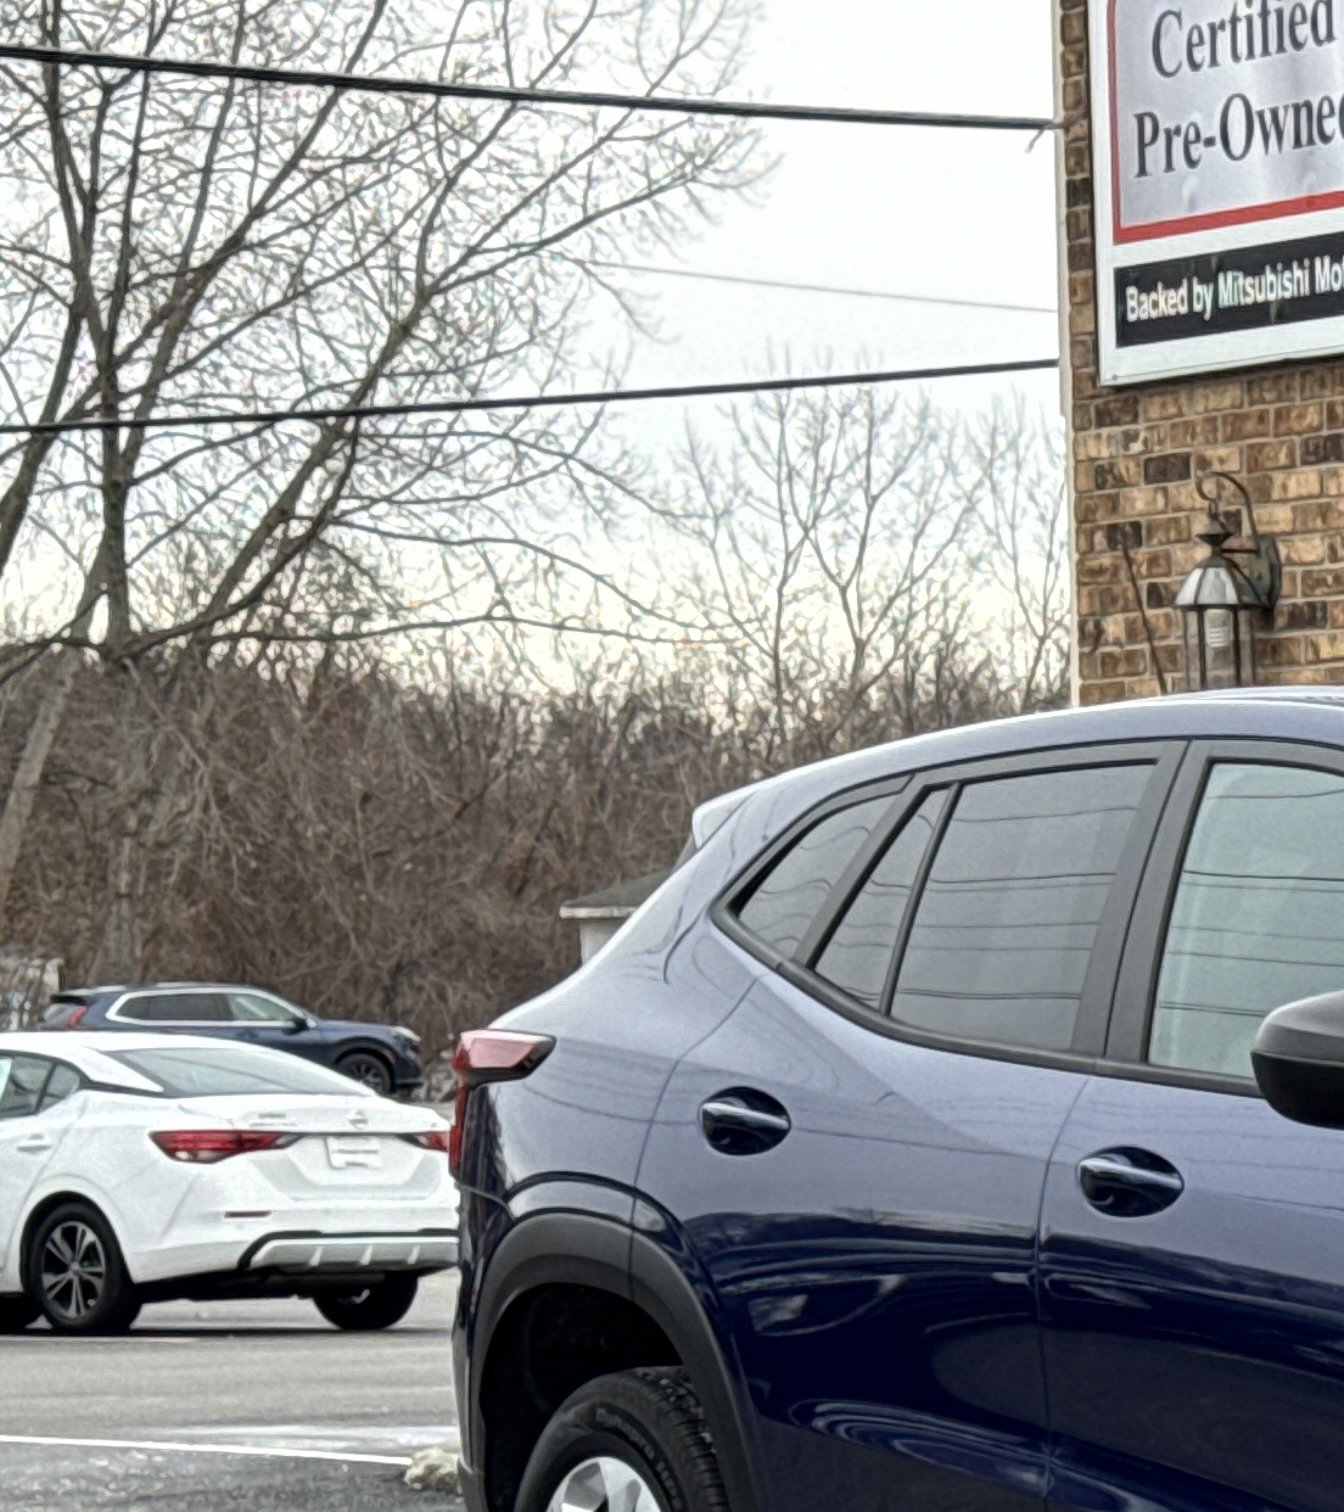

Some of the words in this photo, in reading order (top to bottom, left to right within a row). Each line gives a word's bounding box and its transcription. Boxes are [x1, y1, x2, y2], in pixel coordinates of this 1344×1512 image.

[1152, 0, 1335, 78] Certified
[1125, 280, 1188, 323] Backed
[1192, 276, 1214, 321] by
[1217, 261, 1310, 309] Mitsubishi
